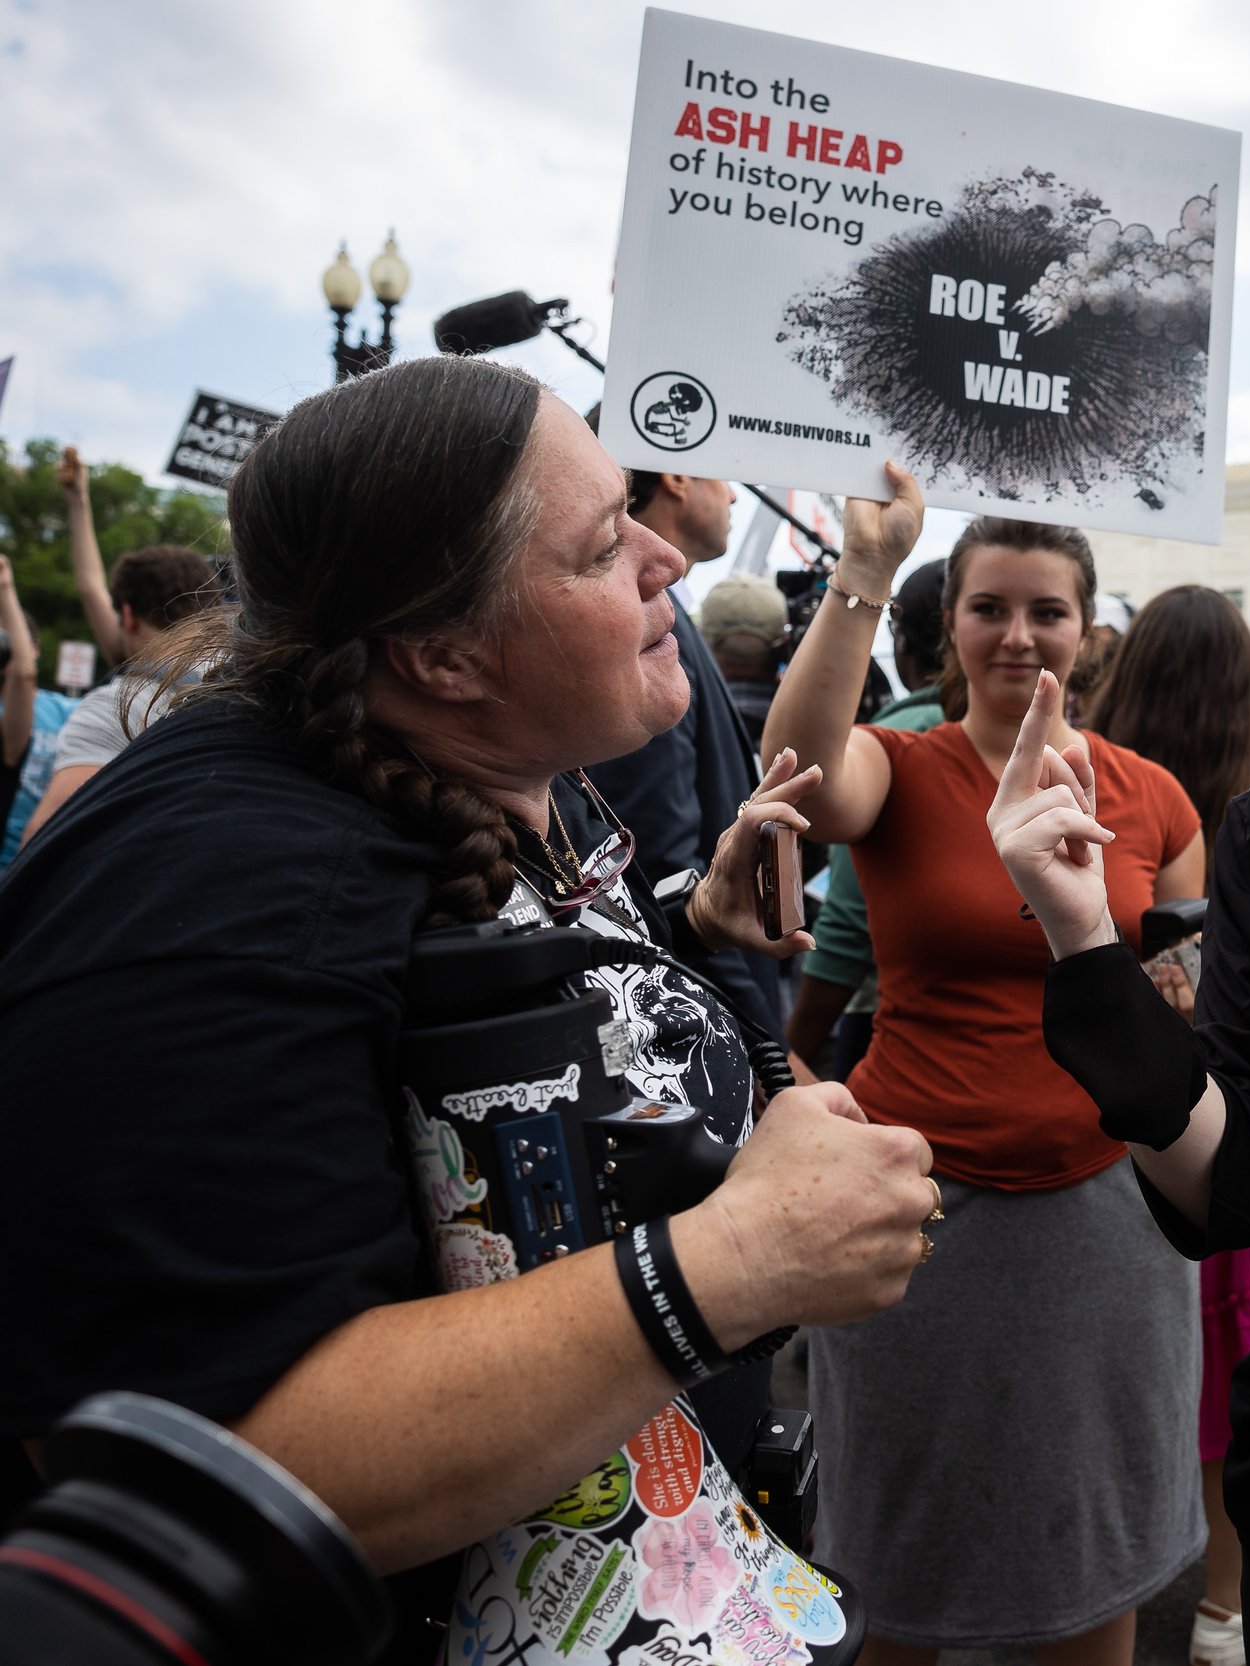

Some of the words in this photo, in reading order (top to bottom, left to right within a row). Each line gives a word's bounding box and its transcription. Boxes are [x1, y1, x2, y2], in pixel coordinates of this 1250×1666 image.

[684, 58, 758, 99] Into
[770, 77, 830, 113] the
[674, 101, 770, 152] ASH
[786, 120, 904, 175] HEAP
[669, 148, 707, 175] of
[716, 152, 831, 204] history
[841, 180, 943, 218] where
[668, 188, 732, 216] you
[745, 193, 864, 246] belong
[929, 273, 1006, 326] ROE
[999, 329, 1022, 361] V.
[964, 361, 1071, 415] WADE
[728, 413, 872, 448] WWW.SURVIVORS.LA
[514, 905, 540, 925] END
[449, 1087, 528, 1117] breathe
[534, 1069, 577, 1108] just
[637, 1252, 660, 1292] THE
[651, 1291, 671, 1314] IN
[663, 1315, 696, 1361] LIVES
[665, 1407, 686, 1462] dignity
[647, 1466, 661, 1480] is
[665, 1472, 684, 1506] with
[677, 1466, 695, 1493] and
[652, 1482, 669, 1509] She
[696, 1535, 711, 1569] CHRIST
[529, 1536, 604, 1630] nothing
[682, 1561, 696, 1592] hope
[579, 1625, 602, 1648] I'm
[593, 1570, 633, 1623] Possible
[731, 1587, 762, 1626] this
[546, 1624, 562, 1640] is
[720, 1609, 746, 1640] can
[761, 1625, 783, 1646] do
